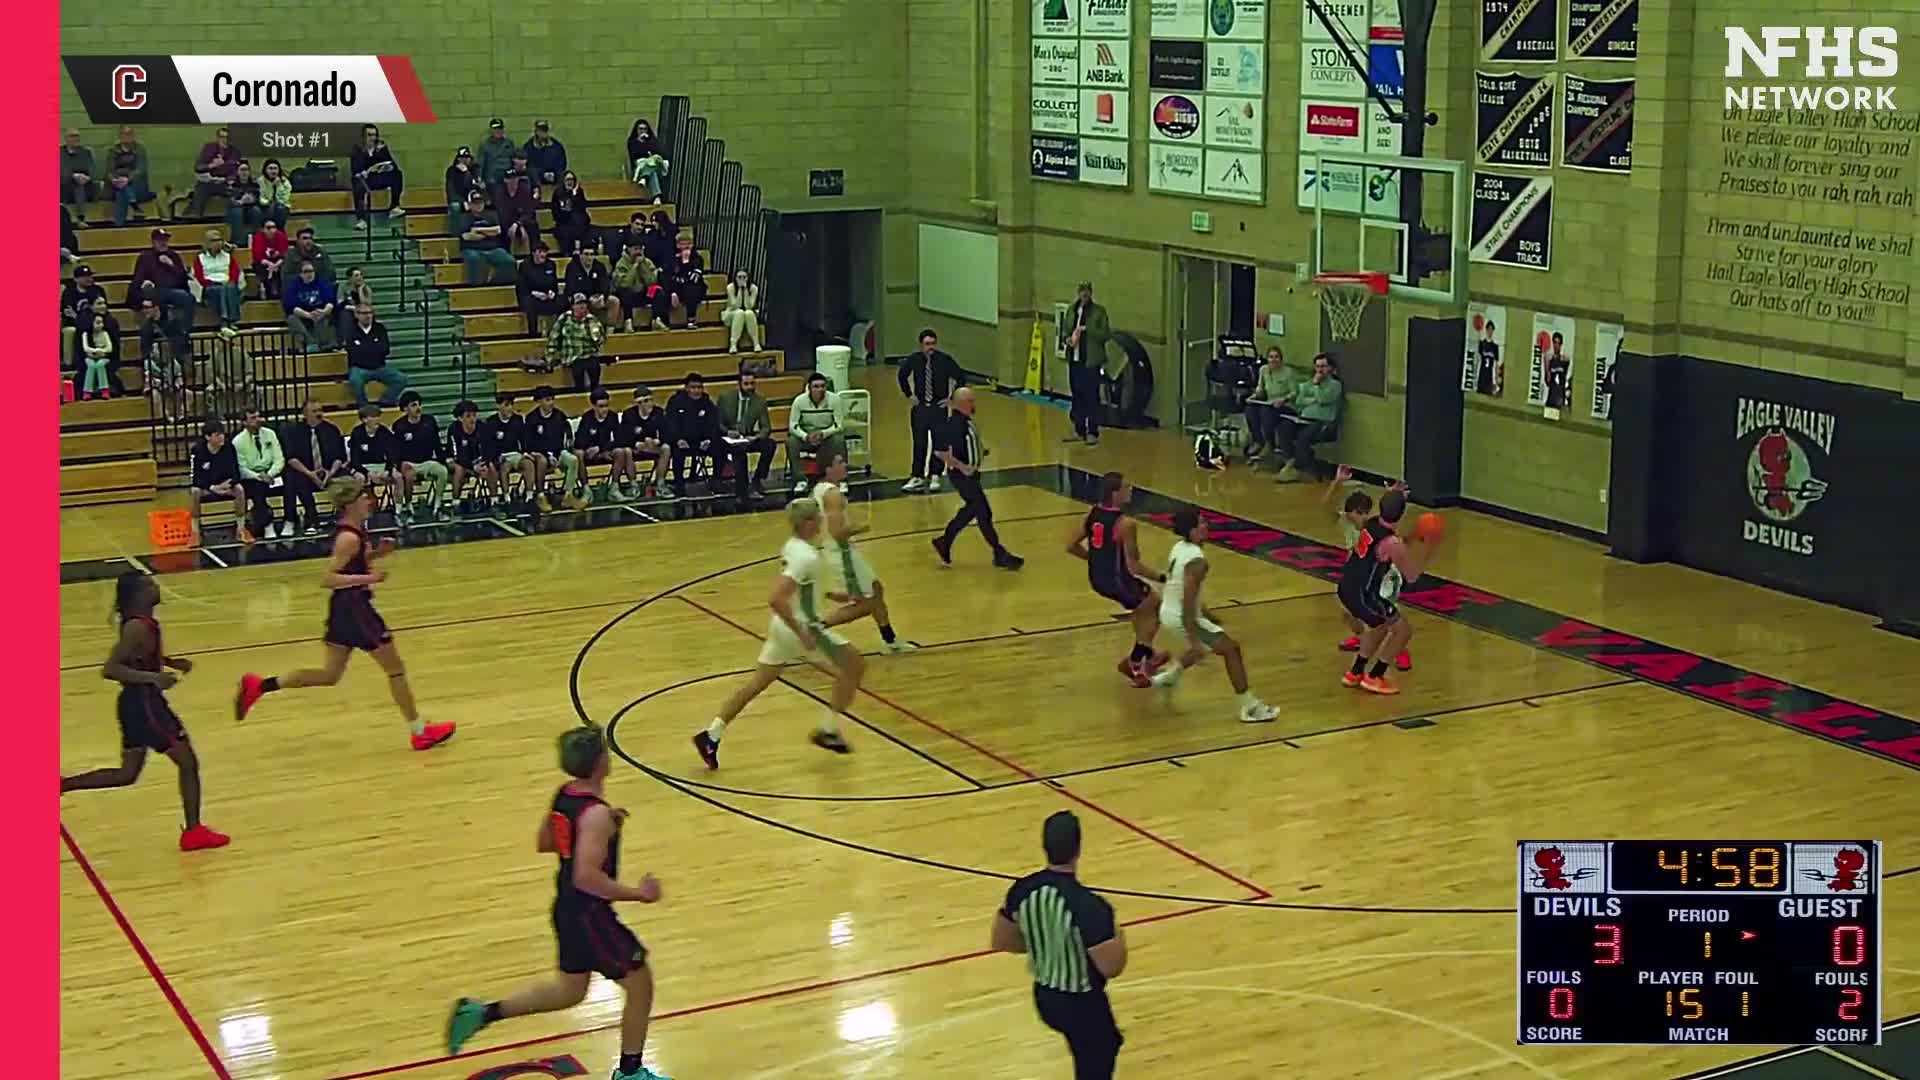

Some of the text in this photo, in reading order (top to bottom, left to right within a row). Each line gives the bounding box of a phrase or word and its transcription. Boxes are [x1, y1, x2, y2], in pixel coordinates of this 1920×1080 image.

[1318, 5, 1364, 16] EDEEMER
[1517, 40, 1555, 50] BASEBALL
[1087, 69, 1125, 83] ANB Bank
[1311, 70, 1356, 82] CONCEPTS
[1033, 99, 1078, 110] COLLETT
[1787, 108, 1828, 128] Valley
[1872, 112, 1920, 133] School
[1480, 135, 1499, 158] STATE
[1721, 125, 1912, 157] We pledge our loyalty and
[1085, 152, 1126, 175] Vail Daily
[1502, 150, 1548, 161] BASKETBALL
[1724, 150, 1901, 182] We shall forever sing our
[1475, 189, 1499, 200] CLASS
[1483, 178, 1503, 189] 2004
[1720, 172, 1770, 193] Praises
[1773, 178, 1787, 194] to
[1792, 182, 1816, 199] you
[1485, 186, 1539, 252] STATE CHAMPIONS
[1519, 240, 1541, 252] BOYS
[1707, 217, 1740, 235] Firm
[1743, 221, 1771, 240] and
[1772, 225, 1852, 249] undaunted
[1855, 235, 1876, 251] we
[1516, 252, 1542, 264] TRACK
[1736, 244, 1878, 278] Strive for your glory
[1739, 265, 1773, 290] Eagle
[1779, 269, 1822, 293] Valley
[1824, 275, 1857, 299] High
[1859, 281, 1911, 305] School
[1730, 289, 1754, 307] Our
[1758, 291, 1788, 313] hats
[1790, 293, 1813, 315] off
[1816, 301, 1832, 317] to
[1465, 351, 1475, 390] DYLAN
[1530, 345, 1543, 400] MALACHI
[1736, 397, 1836, 456] EAGLE VALLEY
[1743, 519, 1814, 555] DEVILS
